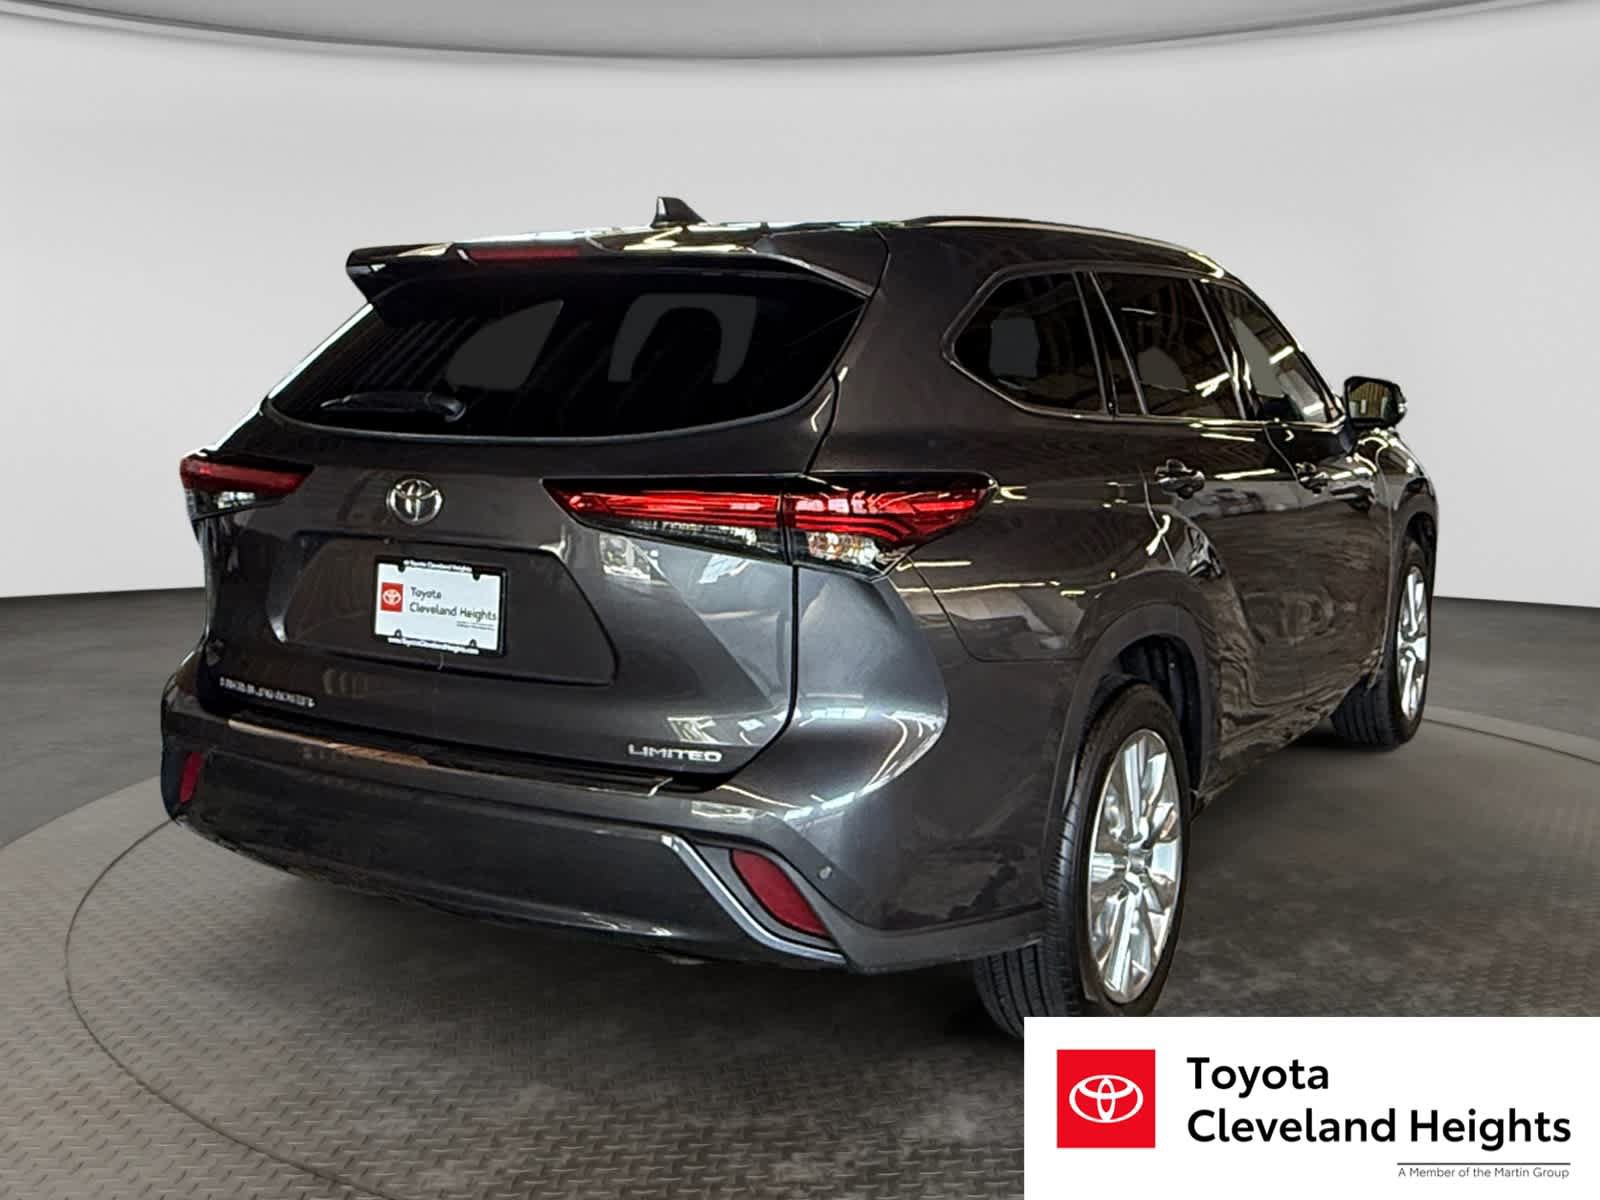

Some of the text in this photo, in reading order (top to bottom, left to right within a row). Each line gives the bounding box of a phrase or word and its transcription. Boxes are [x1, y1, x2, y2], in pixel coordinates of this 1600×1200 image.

[410, 586, 442, 601] Toyota
[409, 601, 497, 622] Cleveland Heights
[627, 743, 723, 762] LIMITED
